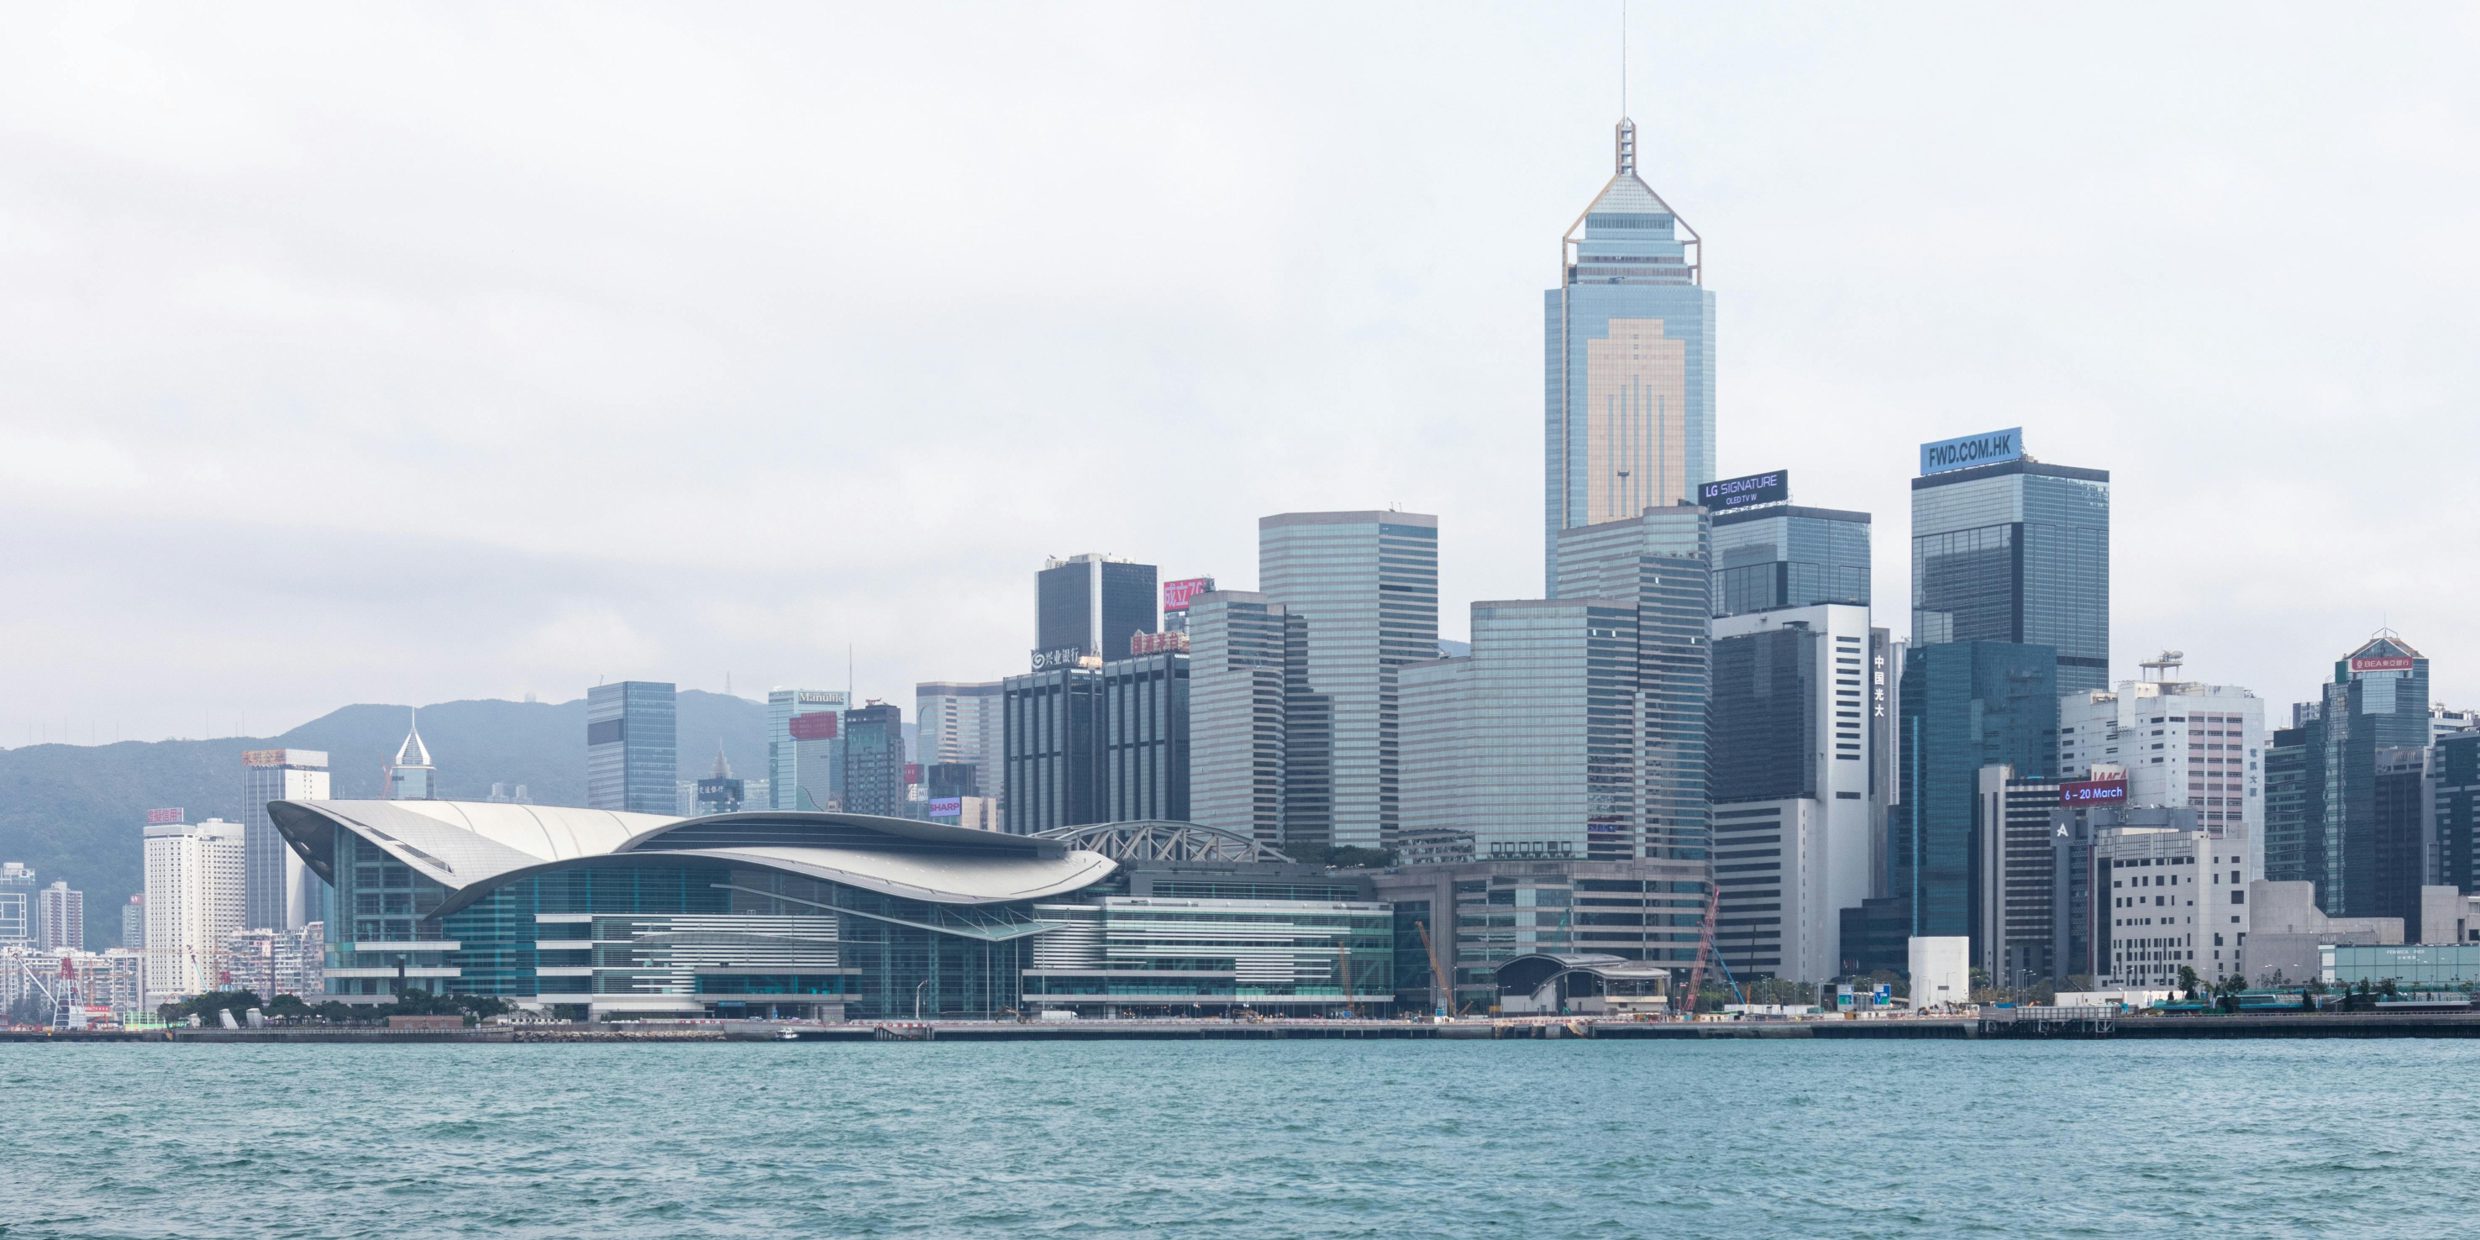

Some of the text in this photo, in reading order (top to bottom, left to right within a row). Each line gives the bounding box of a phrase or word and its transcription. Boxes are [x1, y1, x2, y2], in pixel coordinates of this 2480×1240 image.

[1928, 434, 2011, 467] FWD.COM.HK
[1706, 474, 1777, 498] LG SIGNATURE
[1726, 493, 1757, 505] OLED TV W
[2364, 660, 2382, 668] BEA
[1874, 654, 1884, 717] 中国光大
[2064, 790, 2071, 800] 6
[2080, 788, 2091, 799] 20
[2092, 786, 2123, 799] March
[930, 802, 960, 812] SHARP
